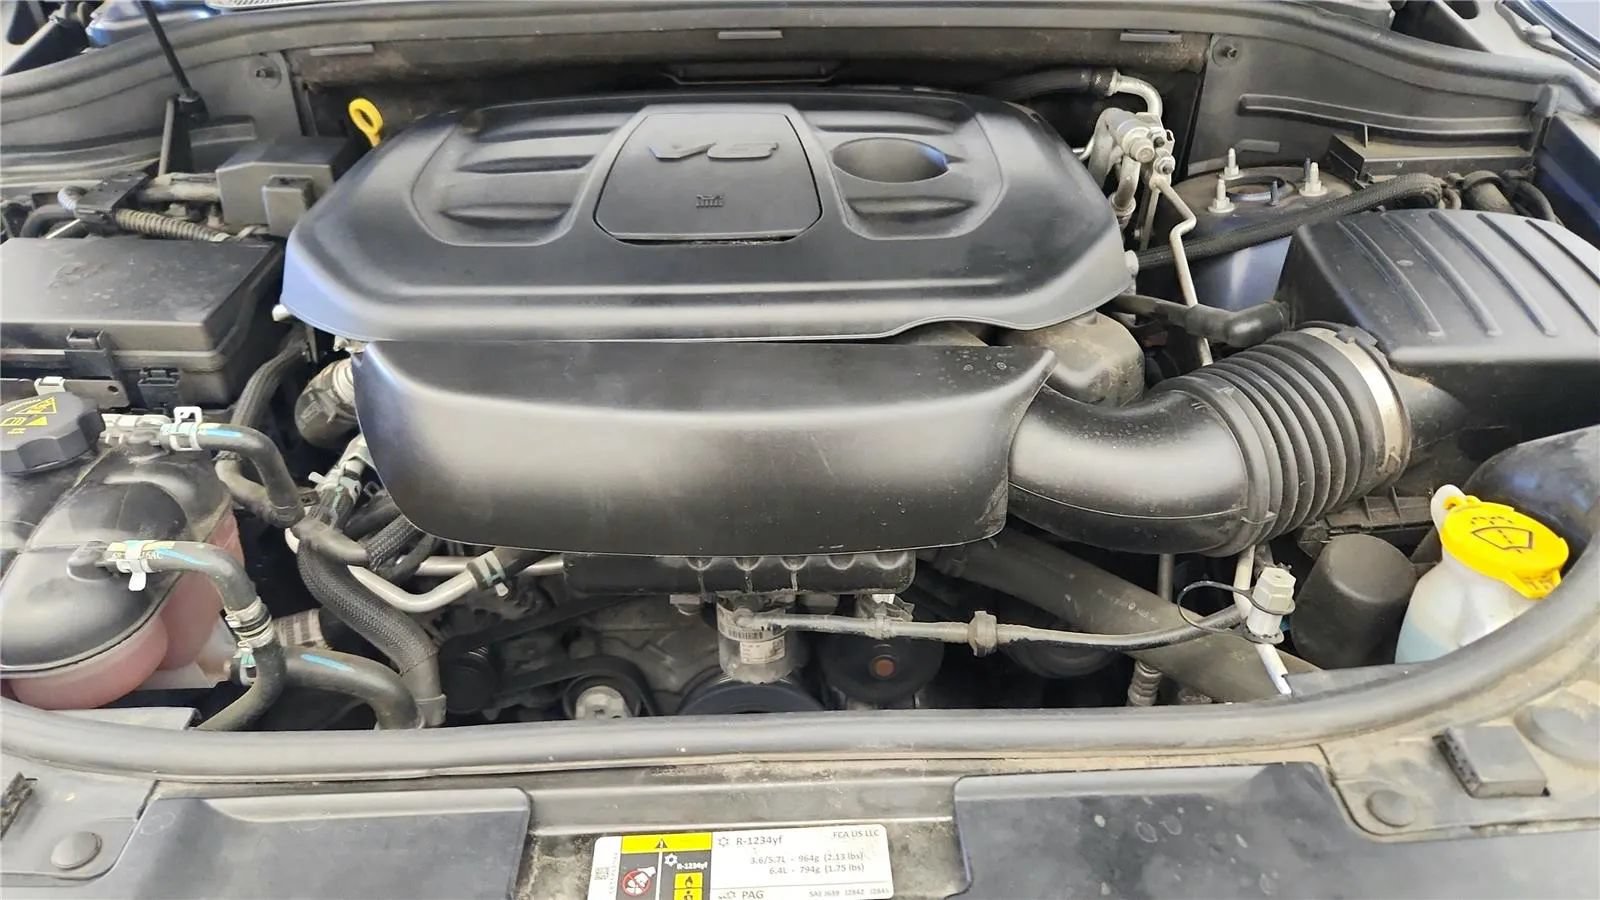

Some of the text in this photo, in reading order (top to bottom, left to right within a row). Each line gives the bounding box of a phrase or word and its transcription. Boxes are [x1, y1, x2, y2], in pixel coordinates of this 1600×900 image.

[649, 142, 779, 161] V6
[736, 835, 782, 846] R-1234yf
[833, 831, 849, 839] FCA
[750, 855, 786, 865] 3.6/5.7L
[798, 854, 820, 863] 964g
[847, 851, 864, 861] lbs)
[769, 867, 788, 875] 6.4L
[800, 866, 821, 874] 794g
[824, 864, 847, 874] (1.75
[849, 863, 865, 873] lbs)
[742, 890, 765, 900] PAG
